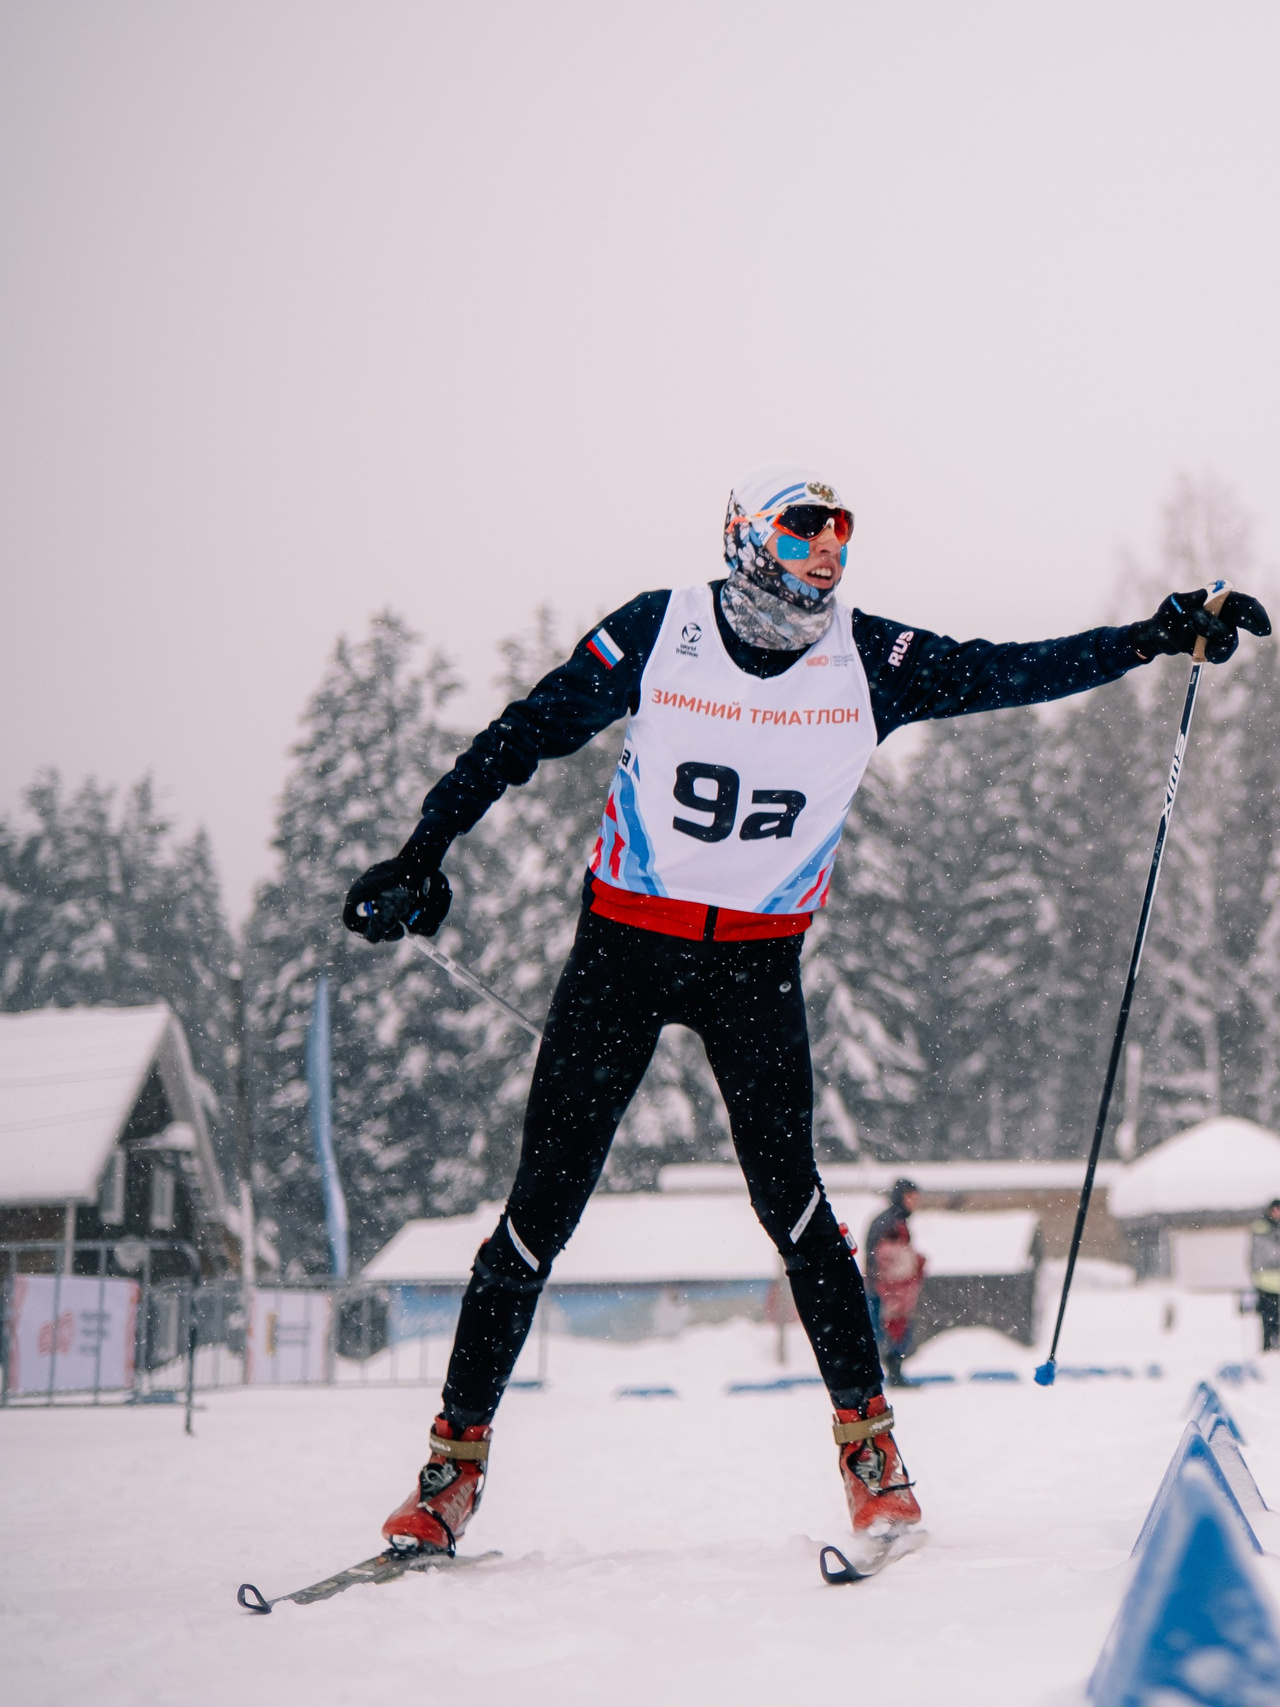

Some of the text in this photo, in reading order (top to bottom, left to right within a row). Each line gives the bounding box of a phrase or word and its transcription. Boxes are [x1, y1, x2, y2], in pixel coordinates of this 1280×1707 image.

[888, 631, 914, 667] RUS
[651, 688, 860, 726] ЗИМНИЙ ТРИАТЛОН
[672, 761, 806, 843] 9a
